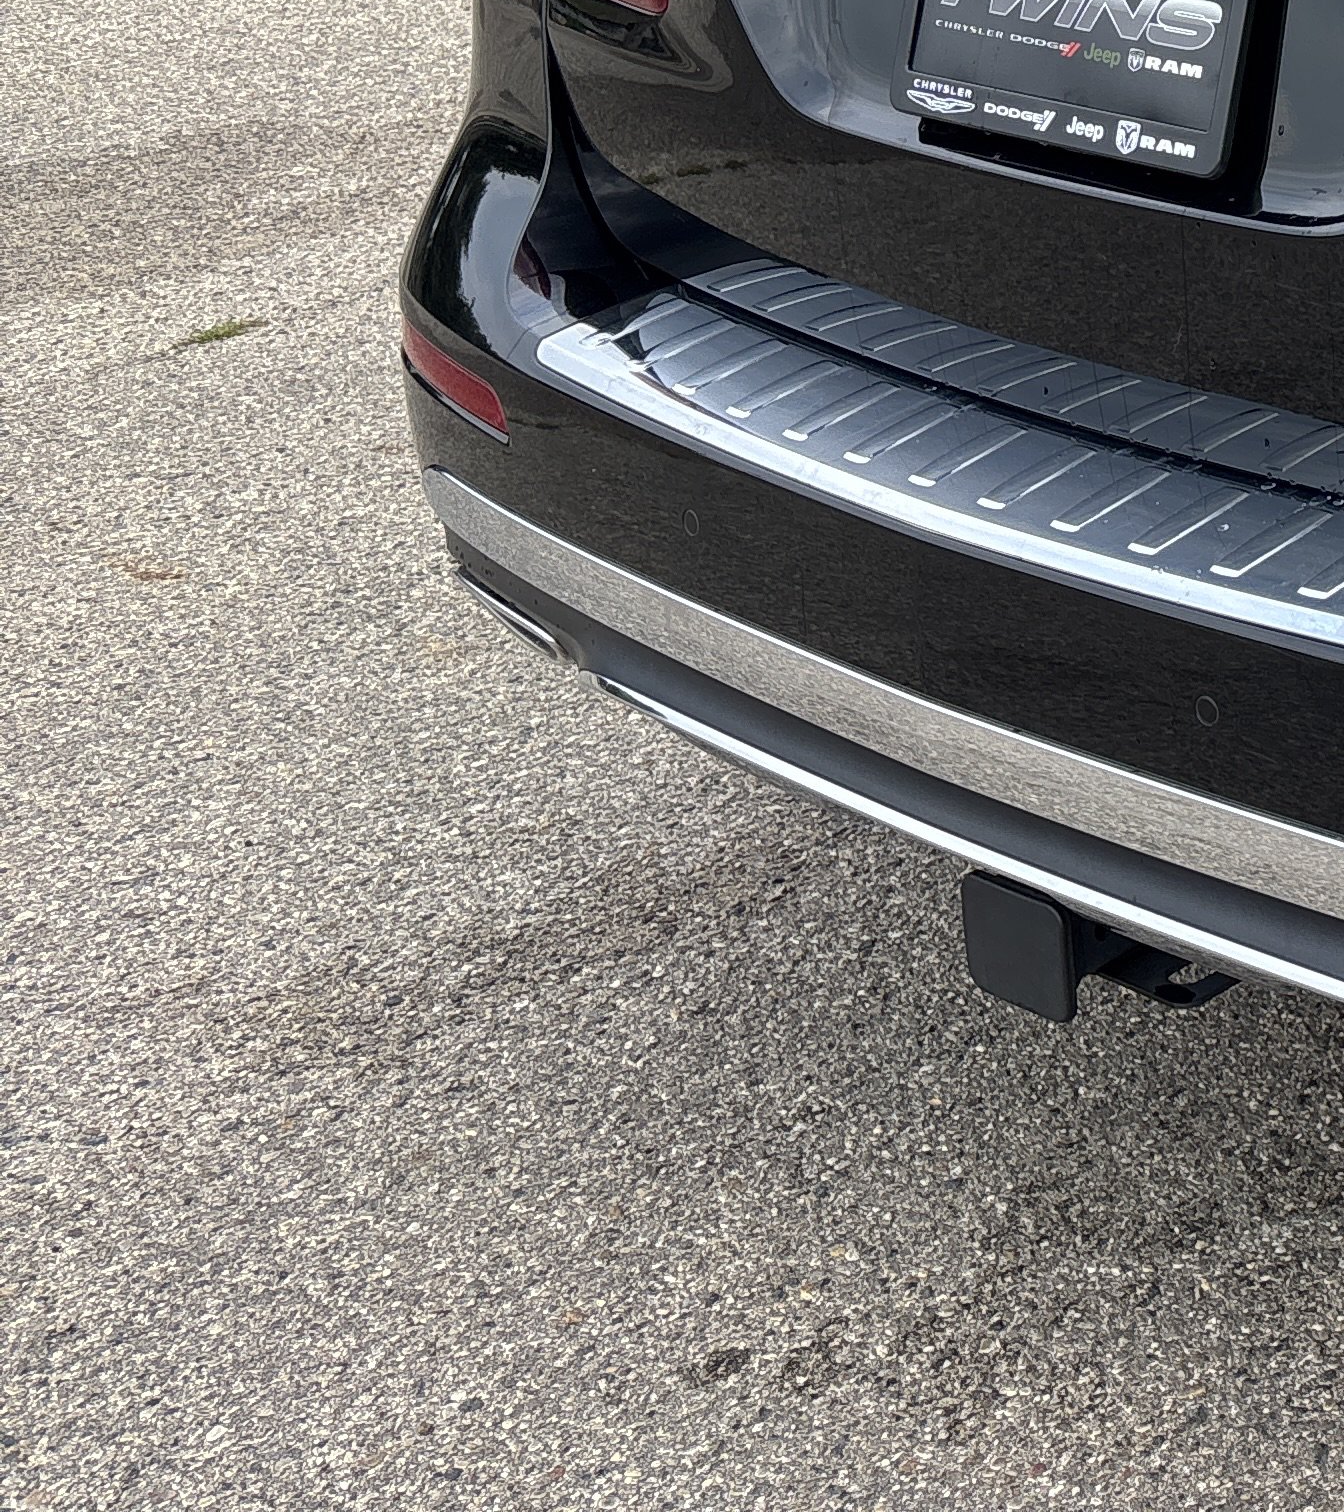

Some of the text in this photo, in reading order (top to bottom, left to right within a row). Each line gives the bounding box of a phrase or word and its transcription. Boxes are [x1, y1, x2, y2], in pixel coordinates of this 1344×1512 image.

[935, 19, 1203, 79] CHRYSLER DODGE Jeep RAM
[912, 77, 1196, 159] CHRYSLER DODGE Jeep RAM
